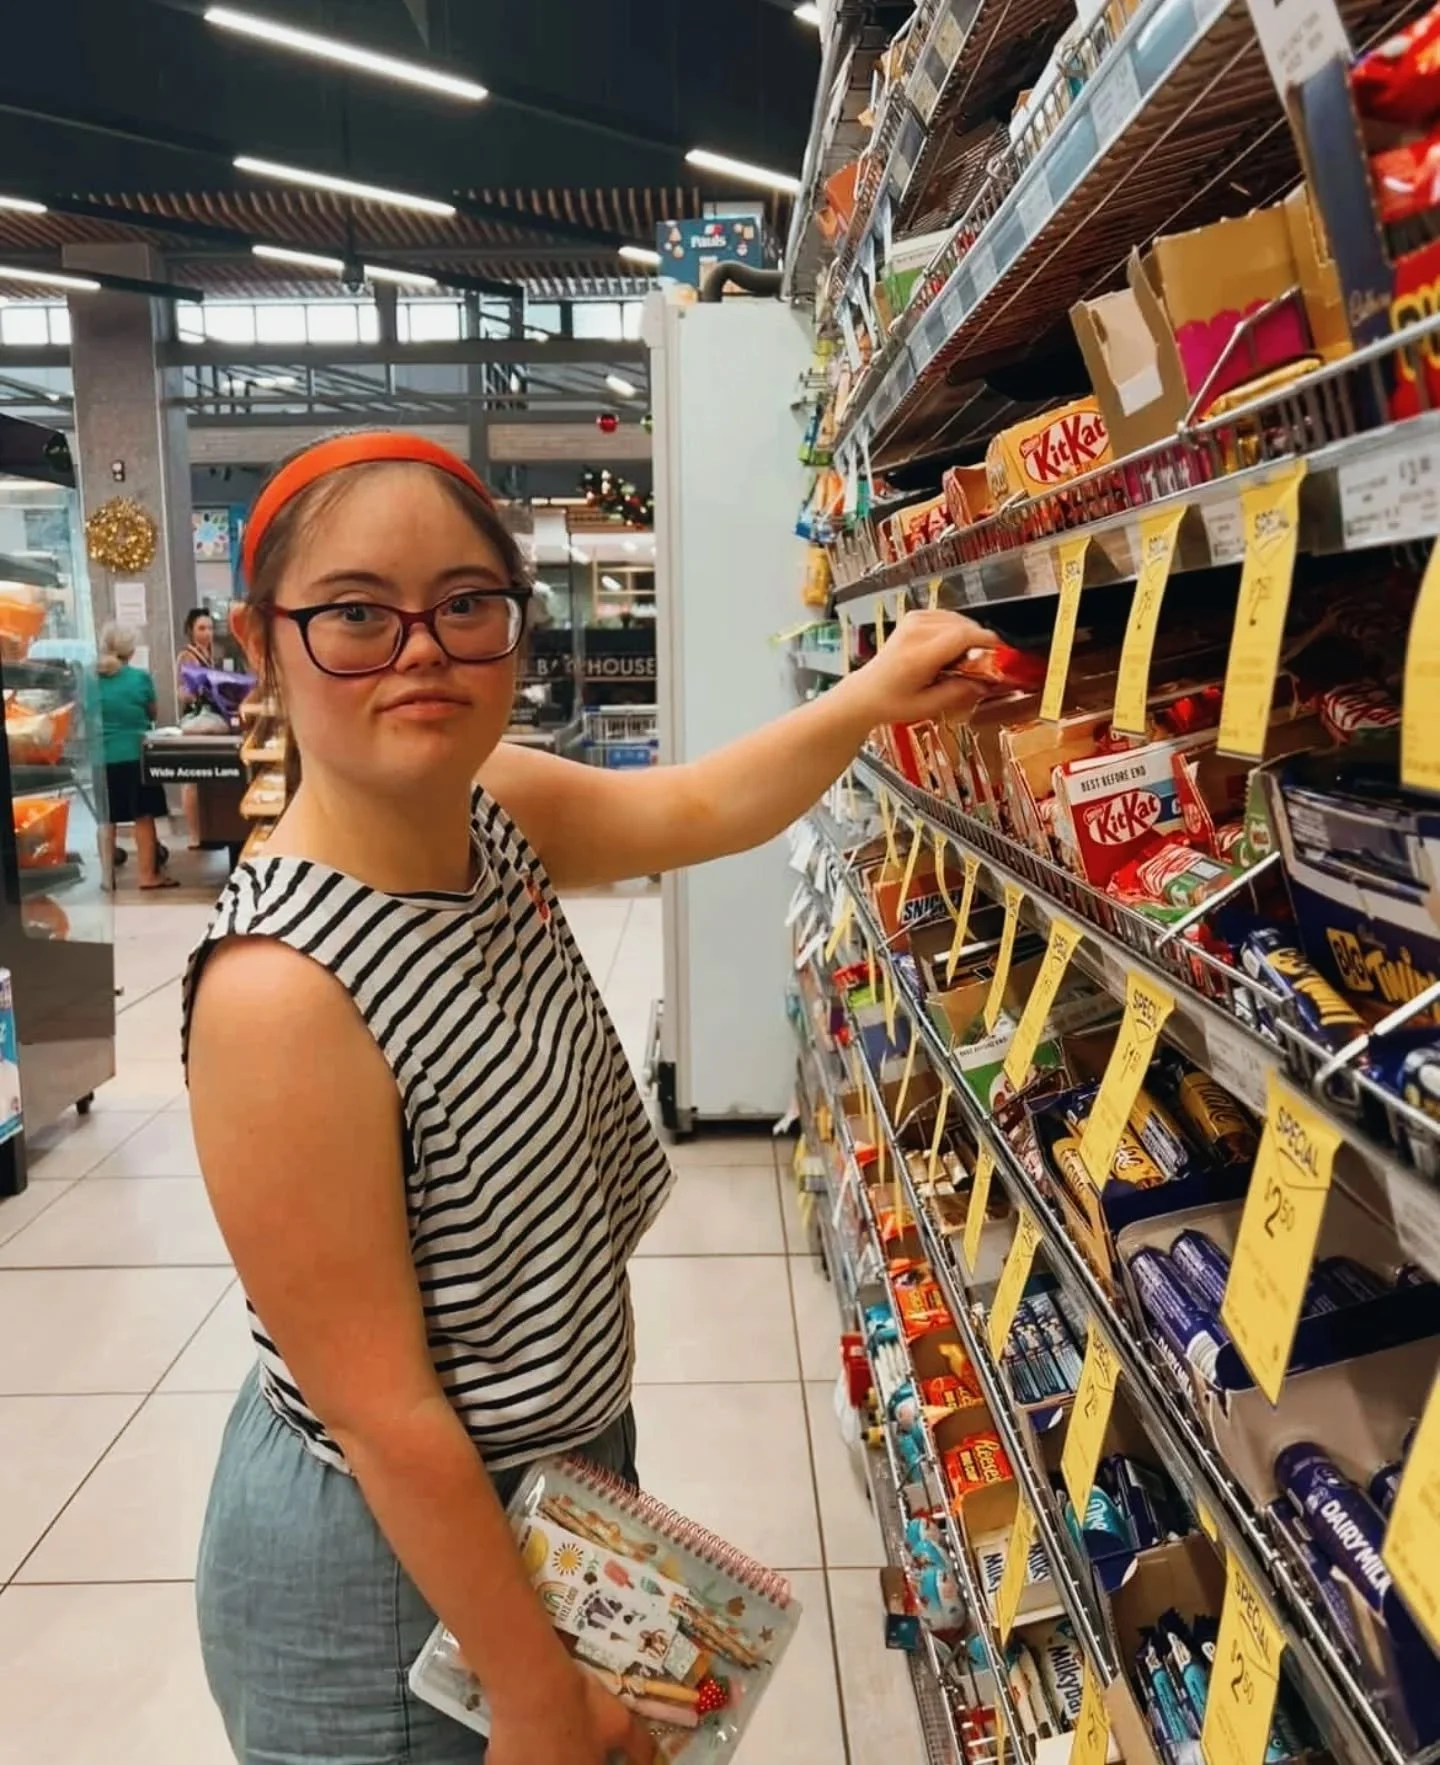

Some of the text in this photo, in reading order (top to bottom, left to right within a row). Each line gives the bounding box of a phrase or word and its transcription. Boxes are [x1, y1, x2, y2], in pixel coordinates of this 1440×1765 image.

[1032, 415, 1106, 481] KitKat
[149, 766, 240, 778] Wide Access Lane
[1080, 764, 1147, 793] BEST BEFORE END
[1096, 791, 1158, 843] KitKat
[1276, 1105, 1319, 1178] SPECIAL
[1320, 1499, 1369, 1551] DAIRY
[1353, 1546, 1392, 1598] MILK
